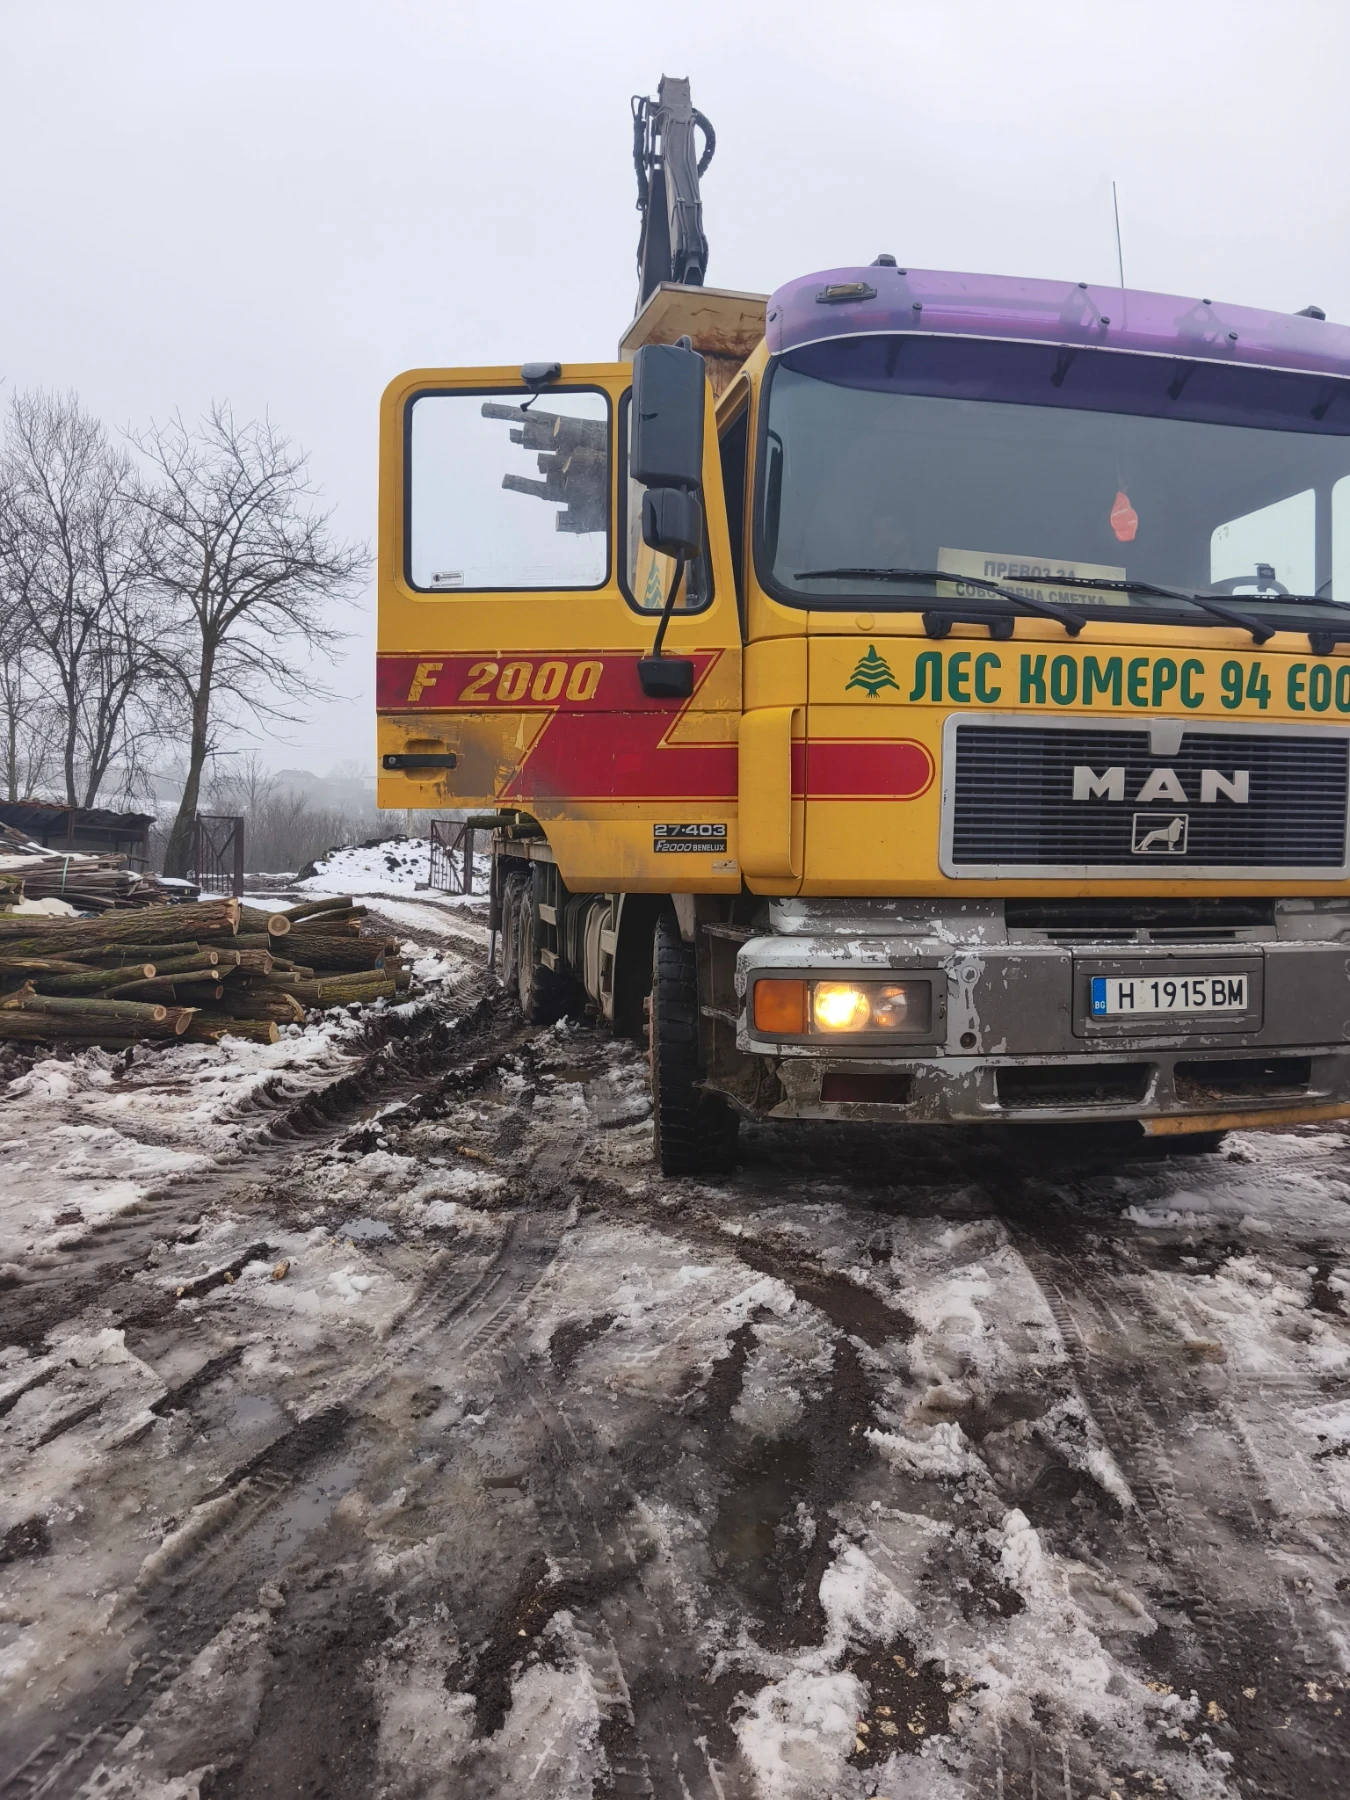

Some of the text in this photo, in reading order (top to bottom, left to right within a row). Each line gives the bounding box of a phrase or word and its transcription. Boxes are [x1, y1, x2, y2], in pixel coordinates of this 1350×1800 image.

[984, 561, 1051, 579] ПРЕВОЗ
[1048, 591, 1108, 605] СМЕТКА
[407, 661, 604, 702] F 2000
[909, 651, 1002, 704] ЛЕС
[1019, 654, 1205, 709] КОМЕРС
[1220, 660, 1271, 710] 94
[1072, 766, 1250, 803] MAN
[655, 840, 692, 852] F2000
[1094, 1001, 1106, 1009] BG
[1119, 983, 1134, 1009] H
